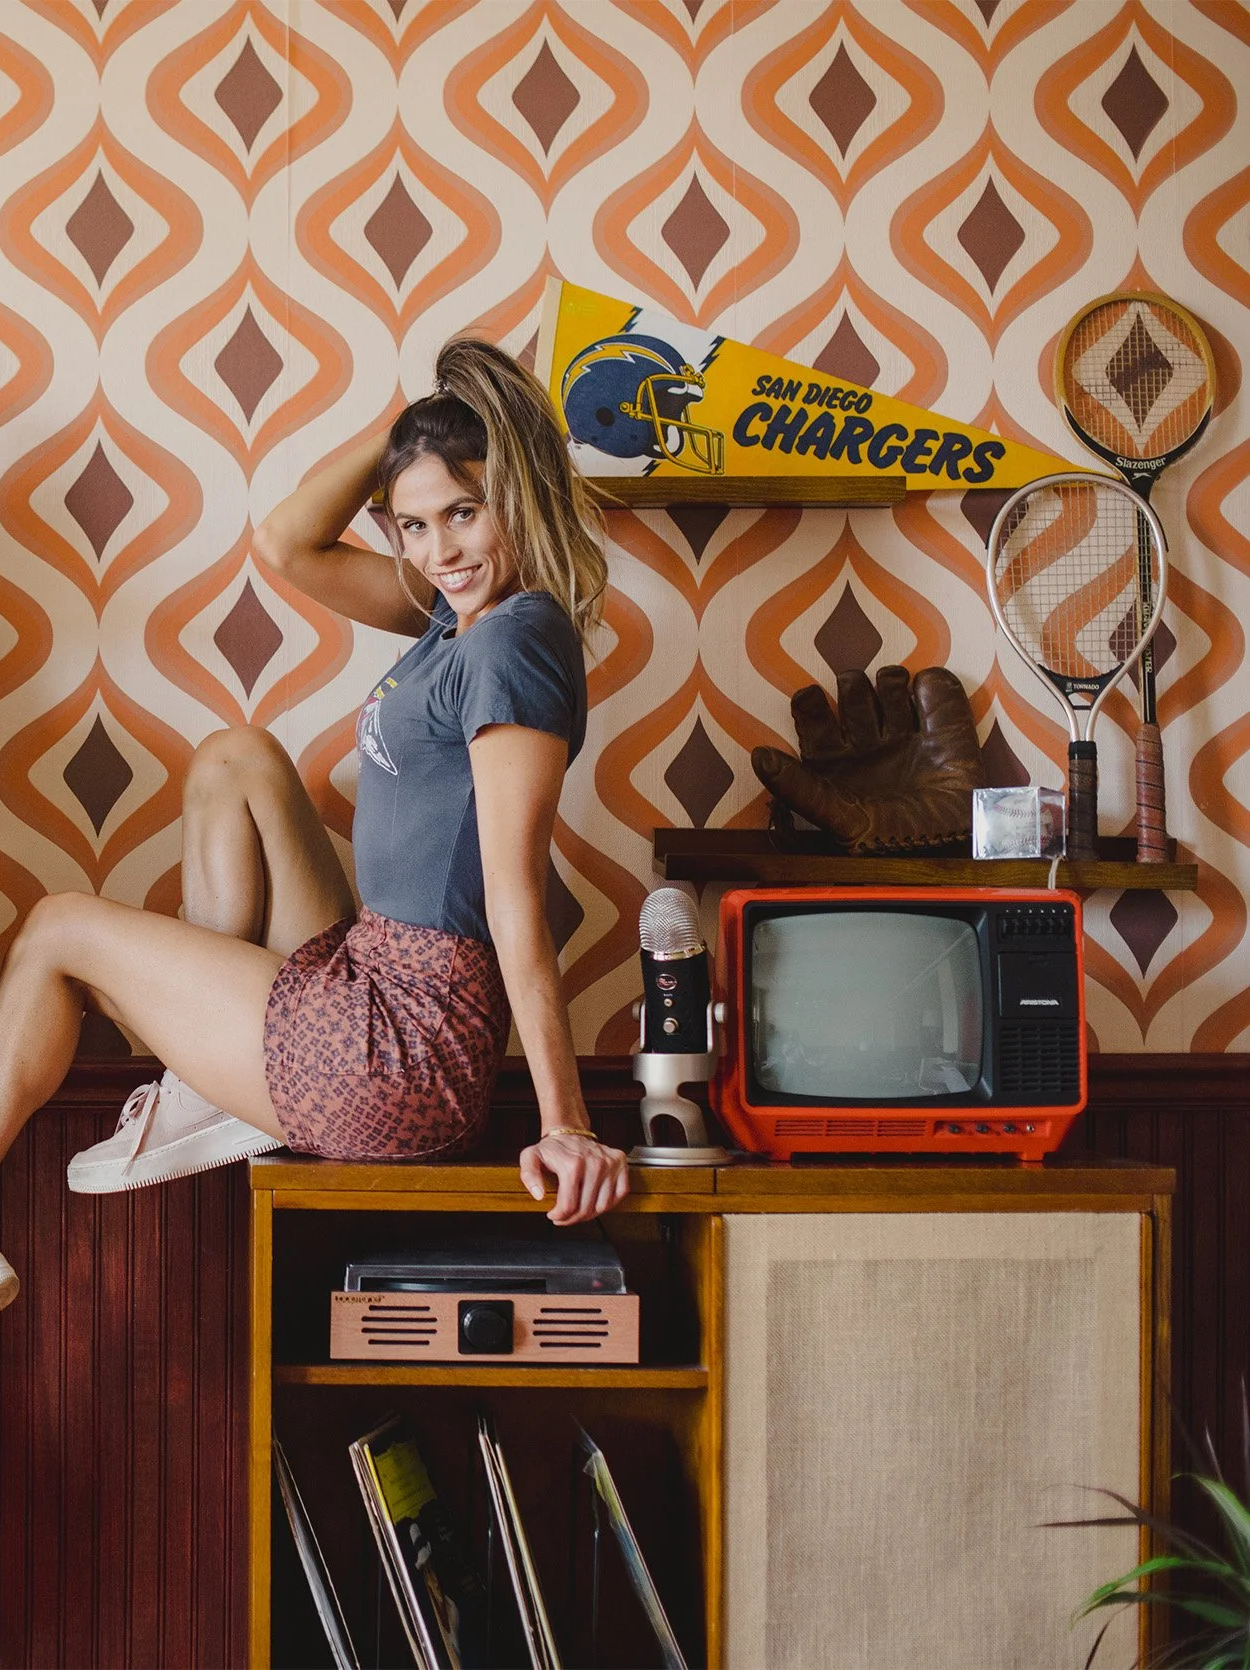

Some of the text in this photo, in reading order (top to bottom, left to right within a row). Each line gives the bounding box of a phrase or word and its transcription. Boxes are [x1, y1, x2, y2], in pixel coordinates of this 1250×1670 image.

[751, 374, 872, 412] SAN DIEGO
[732, 401, 1006, 484] CHARGERS
[1115, 456, 1166, 470] Slazenger
